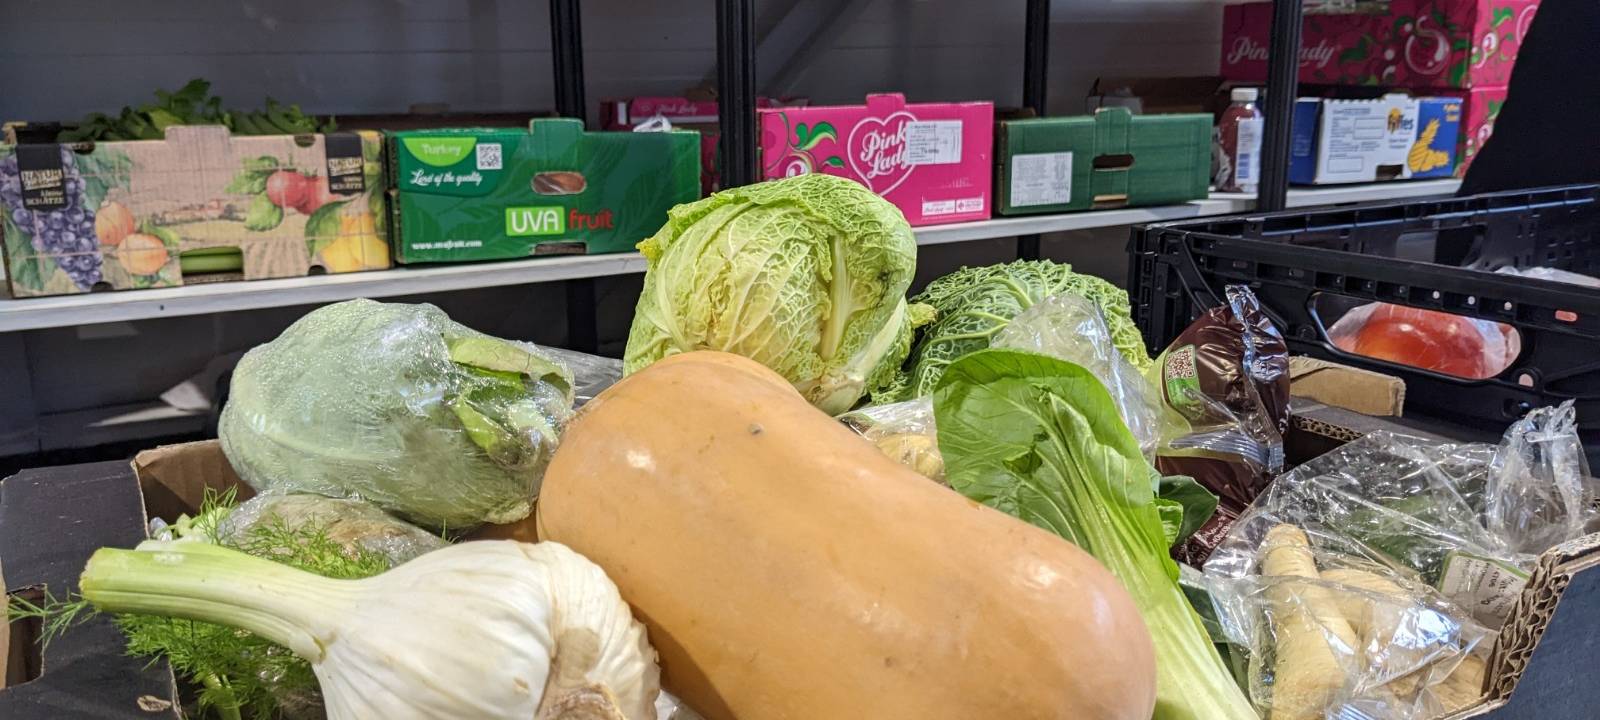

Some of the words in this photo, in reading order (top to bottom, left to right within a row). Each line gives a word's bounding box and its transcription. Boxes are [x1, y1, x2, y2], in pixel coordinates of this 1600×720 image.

[1227, 37, 1269, 64] Pin
[511, 209, 559, 234] UVA
[568, 207, 614, 230] fruit
